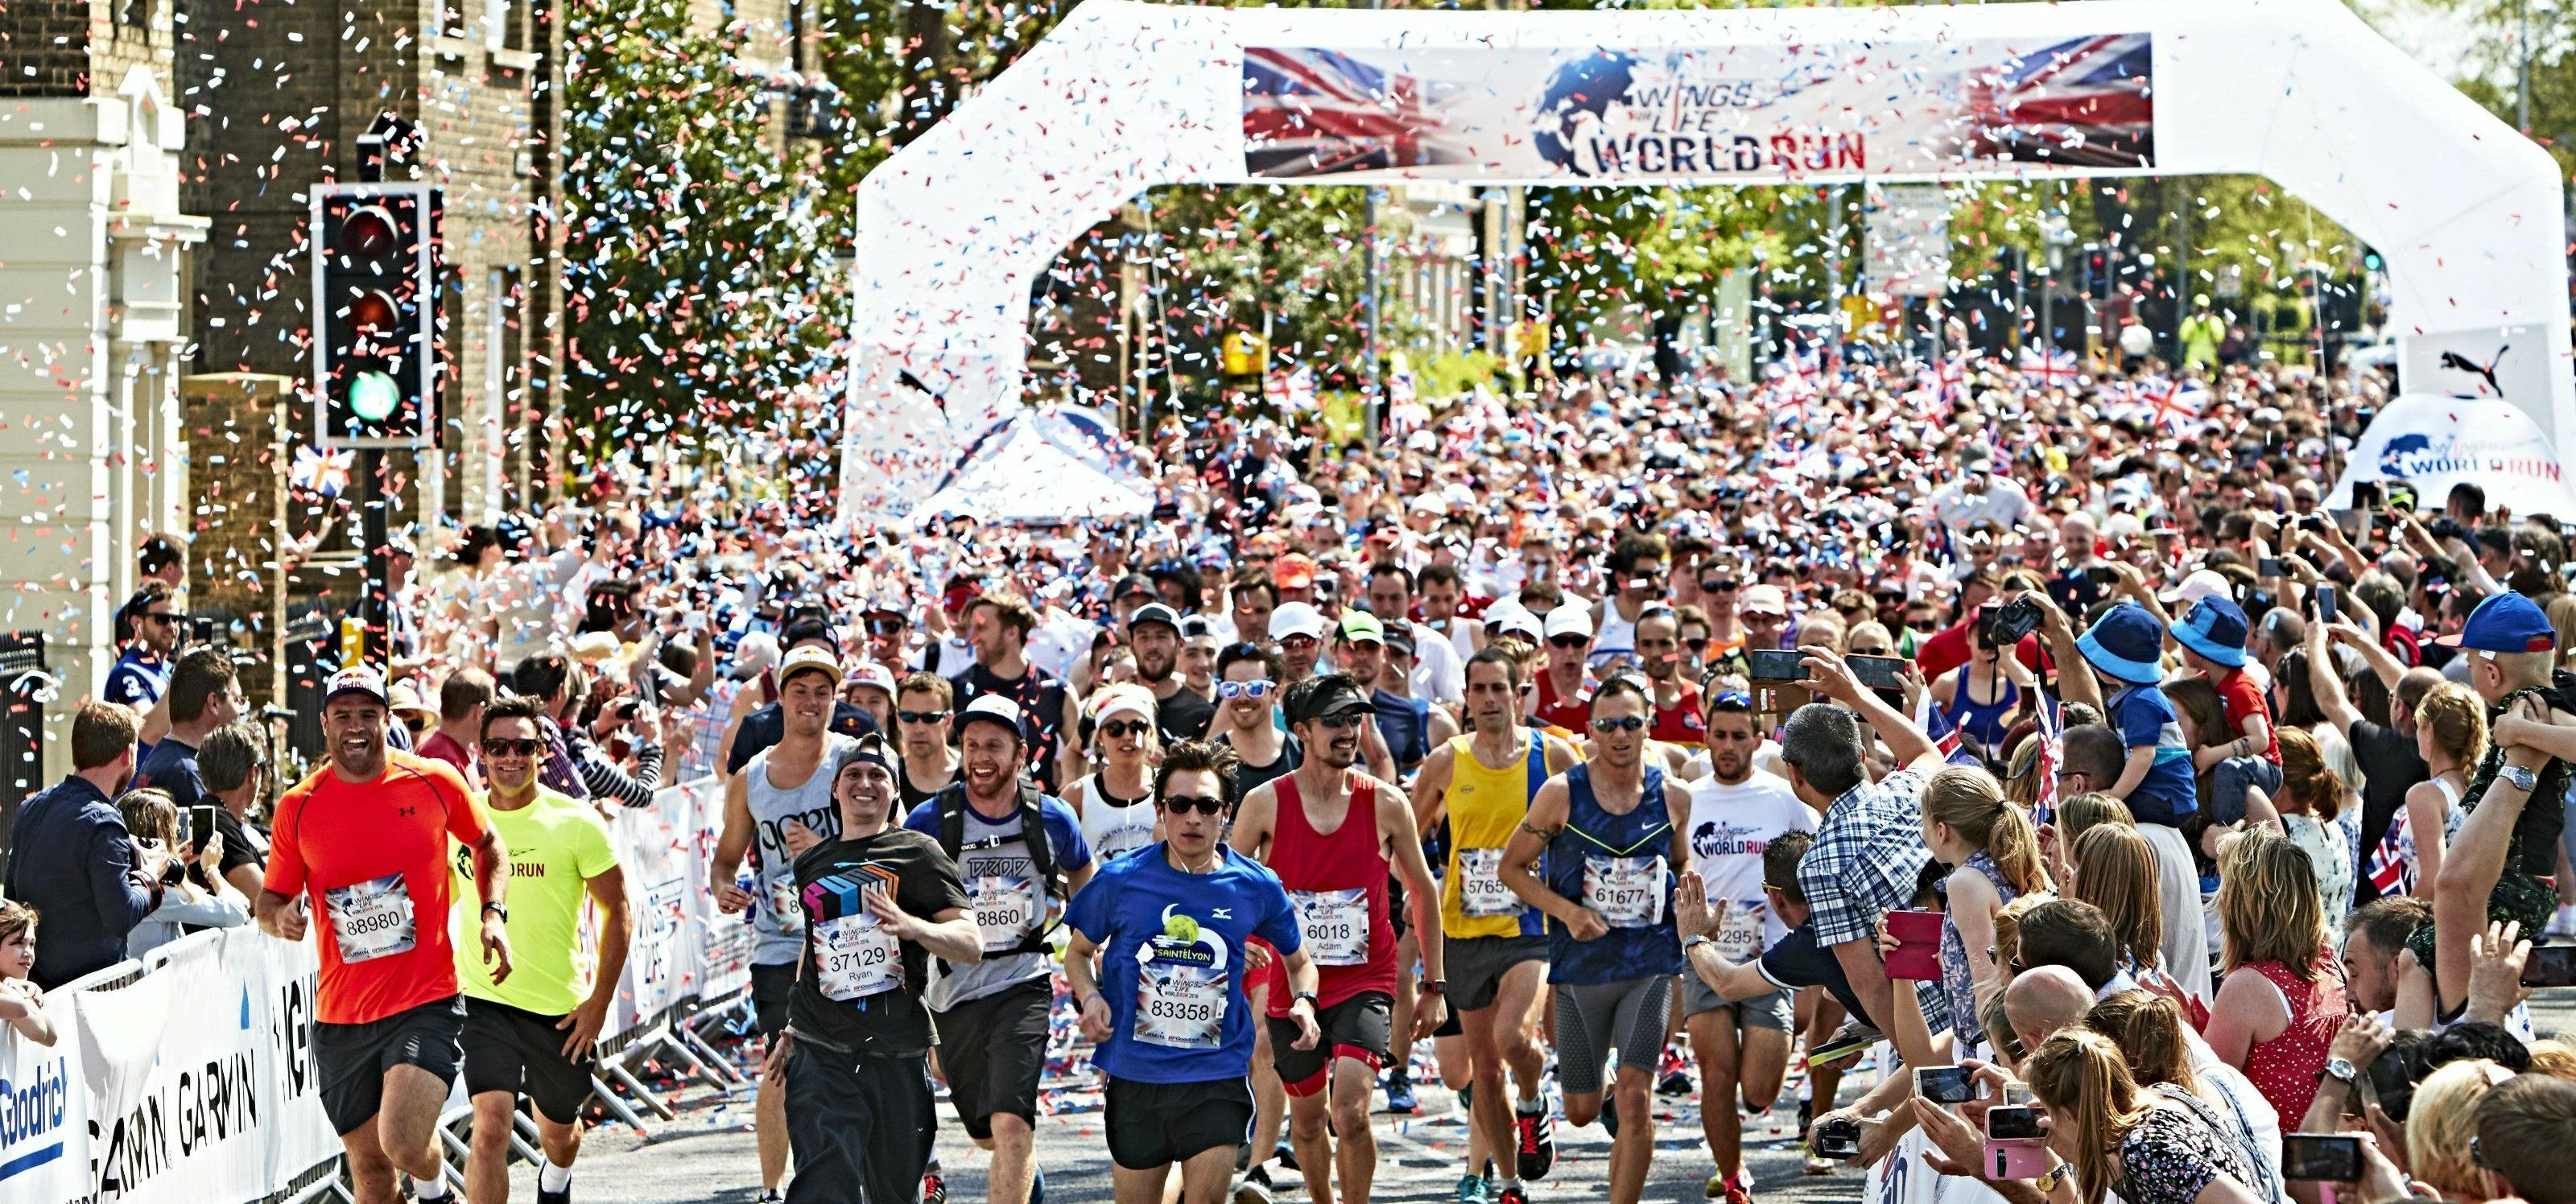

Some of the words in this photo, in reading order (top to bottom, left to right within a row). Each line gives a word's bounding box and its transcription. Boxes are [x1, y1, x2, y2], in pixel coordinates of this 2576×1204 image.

[1637, 84, 1754, 107] WINGS
[1652, 109, 1719, 132] LIFE
[1589, 134, 1761, 173] WORLD
[1769, 132, 1867, 171] RUN
[337, 680, 353, 689] Red
[354, 681, 372, 691] Bull
[1703, 841, 1745, 856] WORLD
[1746, 840, 1767, 854] RU
[516, 863, 545, 877] RUN
[1469, 879, 1511, 894] 5765
[1596, 888, 1644, 904] 61677
[346, 911, 399, 935] 88980
[977, 909, 1018, 926] 8860
[841, 927, 865, 936] WINGS
[1307, 924, 1349, 939] 6018
[830, 947, 886, 972] 37129
[849, 971, 873, 982] Ryan
[1173, 979, 1199, 988] WINGS
[824, 988, 851, 997] GARMIN
[1151, 1000, 1209, 1021] 83358
[1137, 1030, 1165, 1039] GARMIN
[179, 1049, 257, 1157] GARMIN
